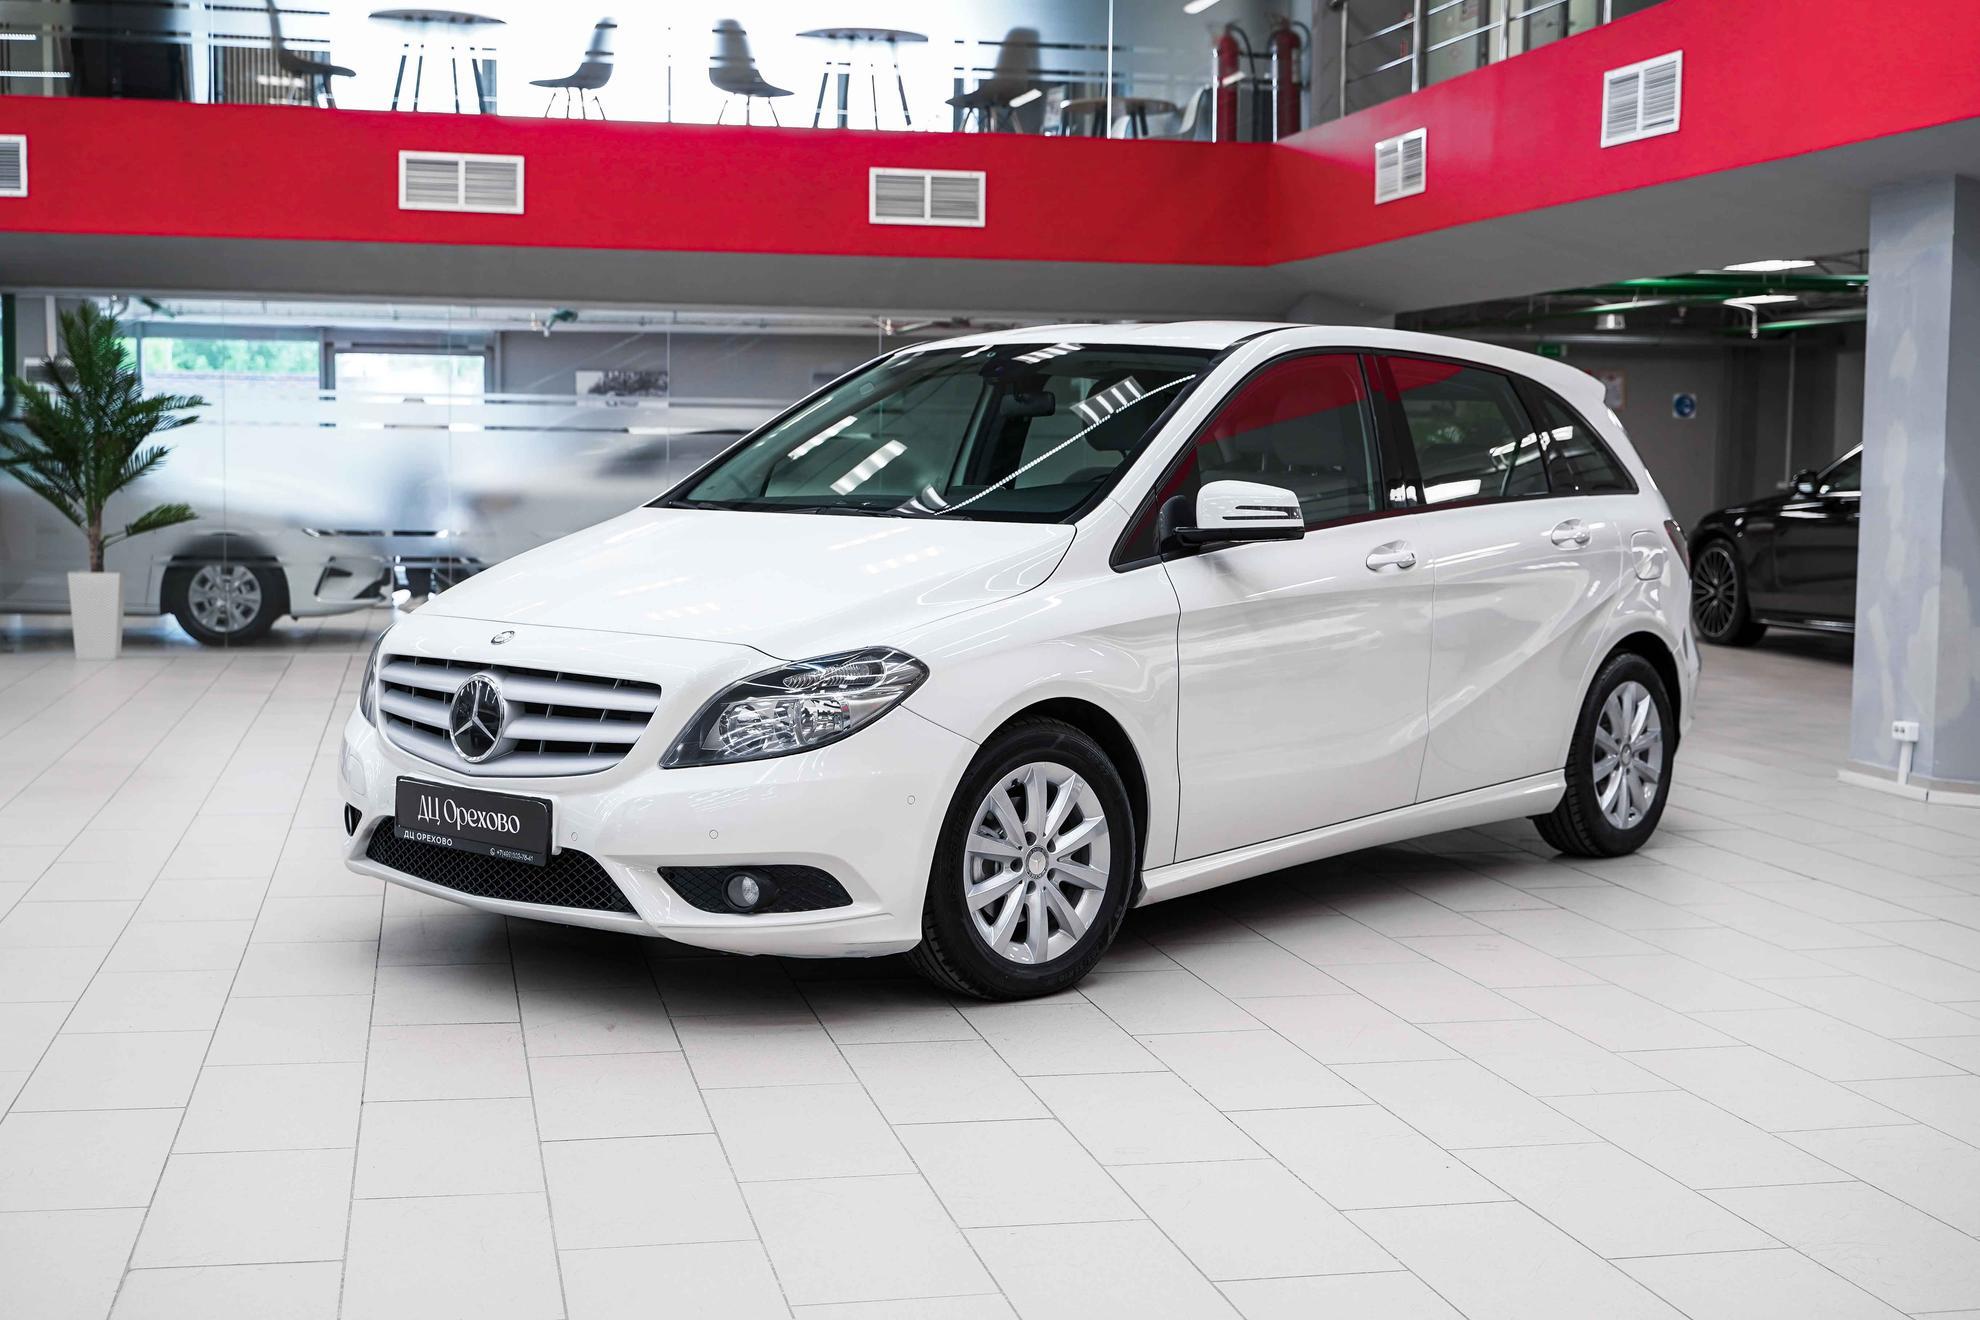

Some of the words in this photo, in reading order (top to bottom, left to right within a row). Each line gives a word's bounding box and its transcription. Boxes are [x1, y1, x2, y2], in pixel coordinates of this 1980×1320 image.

[417, 795, 441, 826] ДЦ
[443, 799, 521, 834] Орехово
[403, 830, 415, 840] ДЦ
[416, 832, 453, 847] ОРЕХОВО
